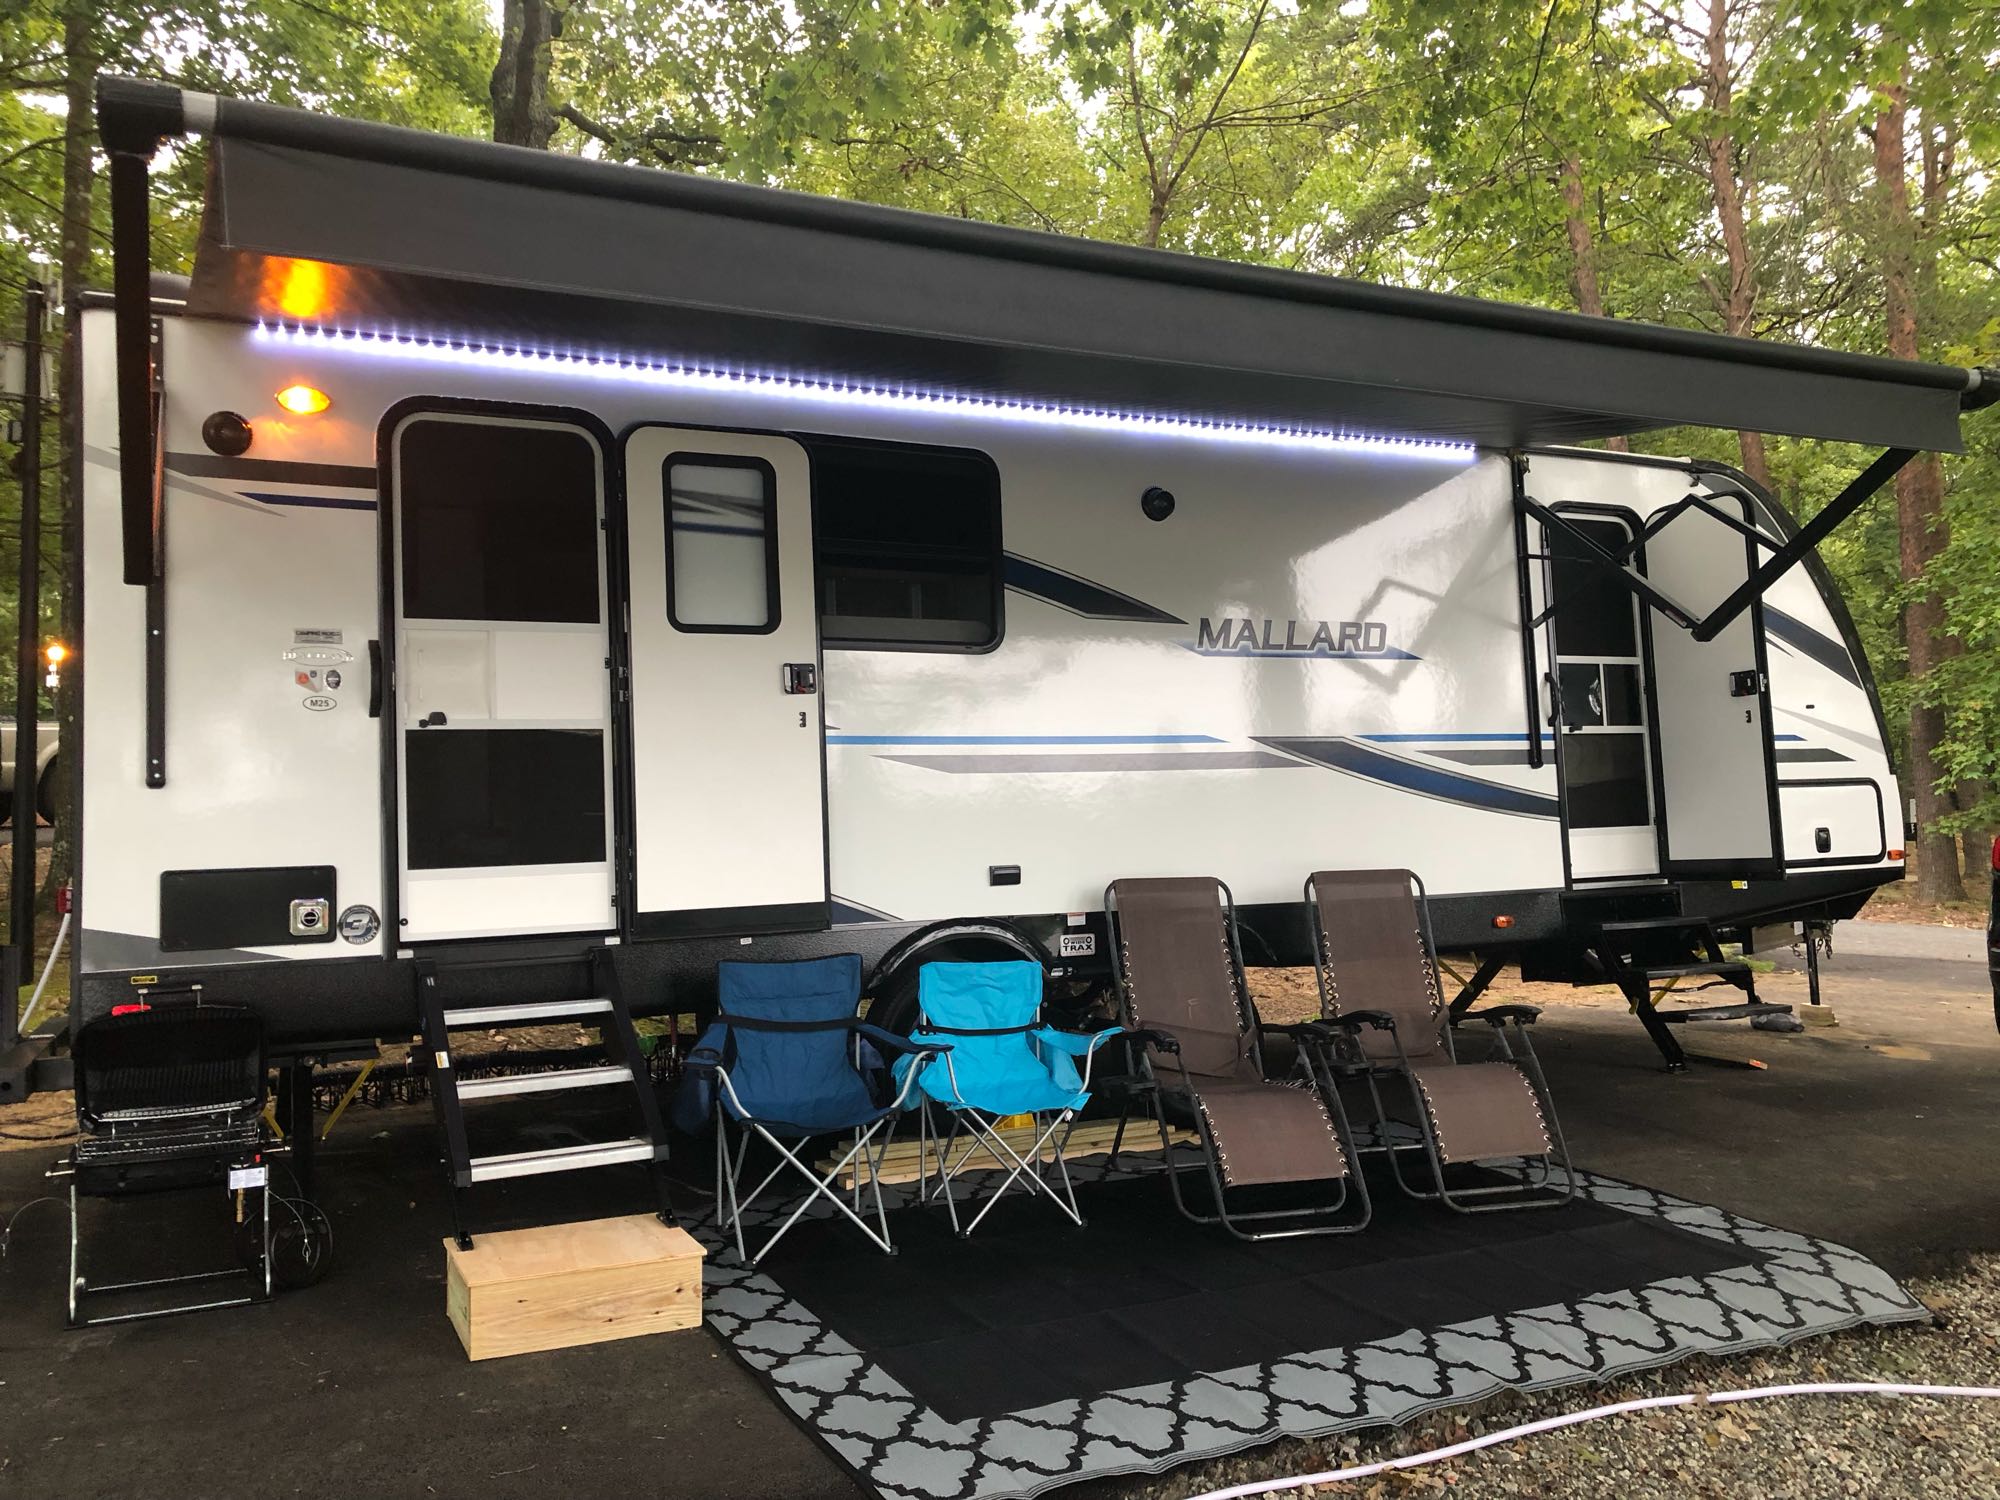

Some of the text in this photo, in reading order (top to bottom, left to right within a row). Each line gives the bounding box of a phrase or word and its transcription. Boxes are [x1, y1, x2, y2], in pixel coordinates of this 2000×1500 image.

[1197, 617, 1387, 652] MALLARD
[310, 699, 330, 707] M25
[342, 913, 370, 936] 3
[1062, 944, 1092, 952] TRAX
